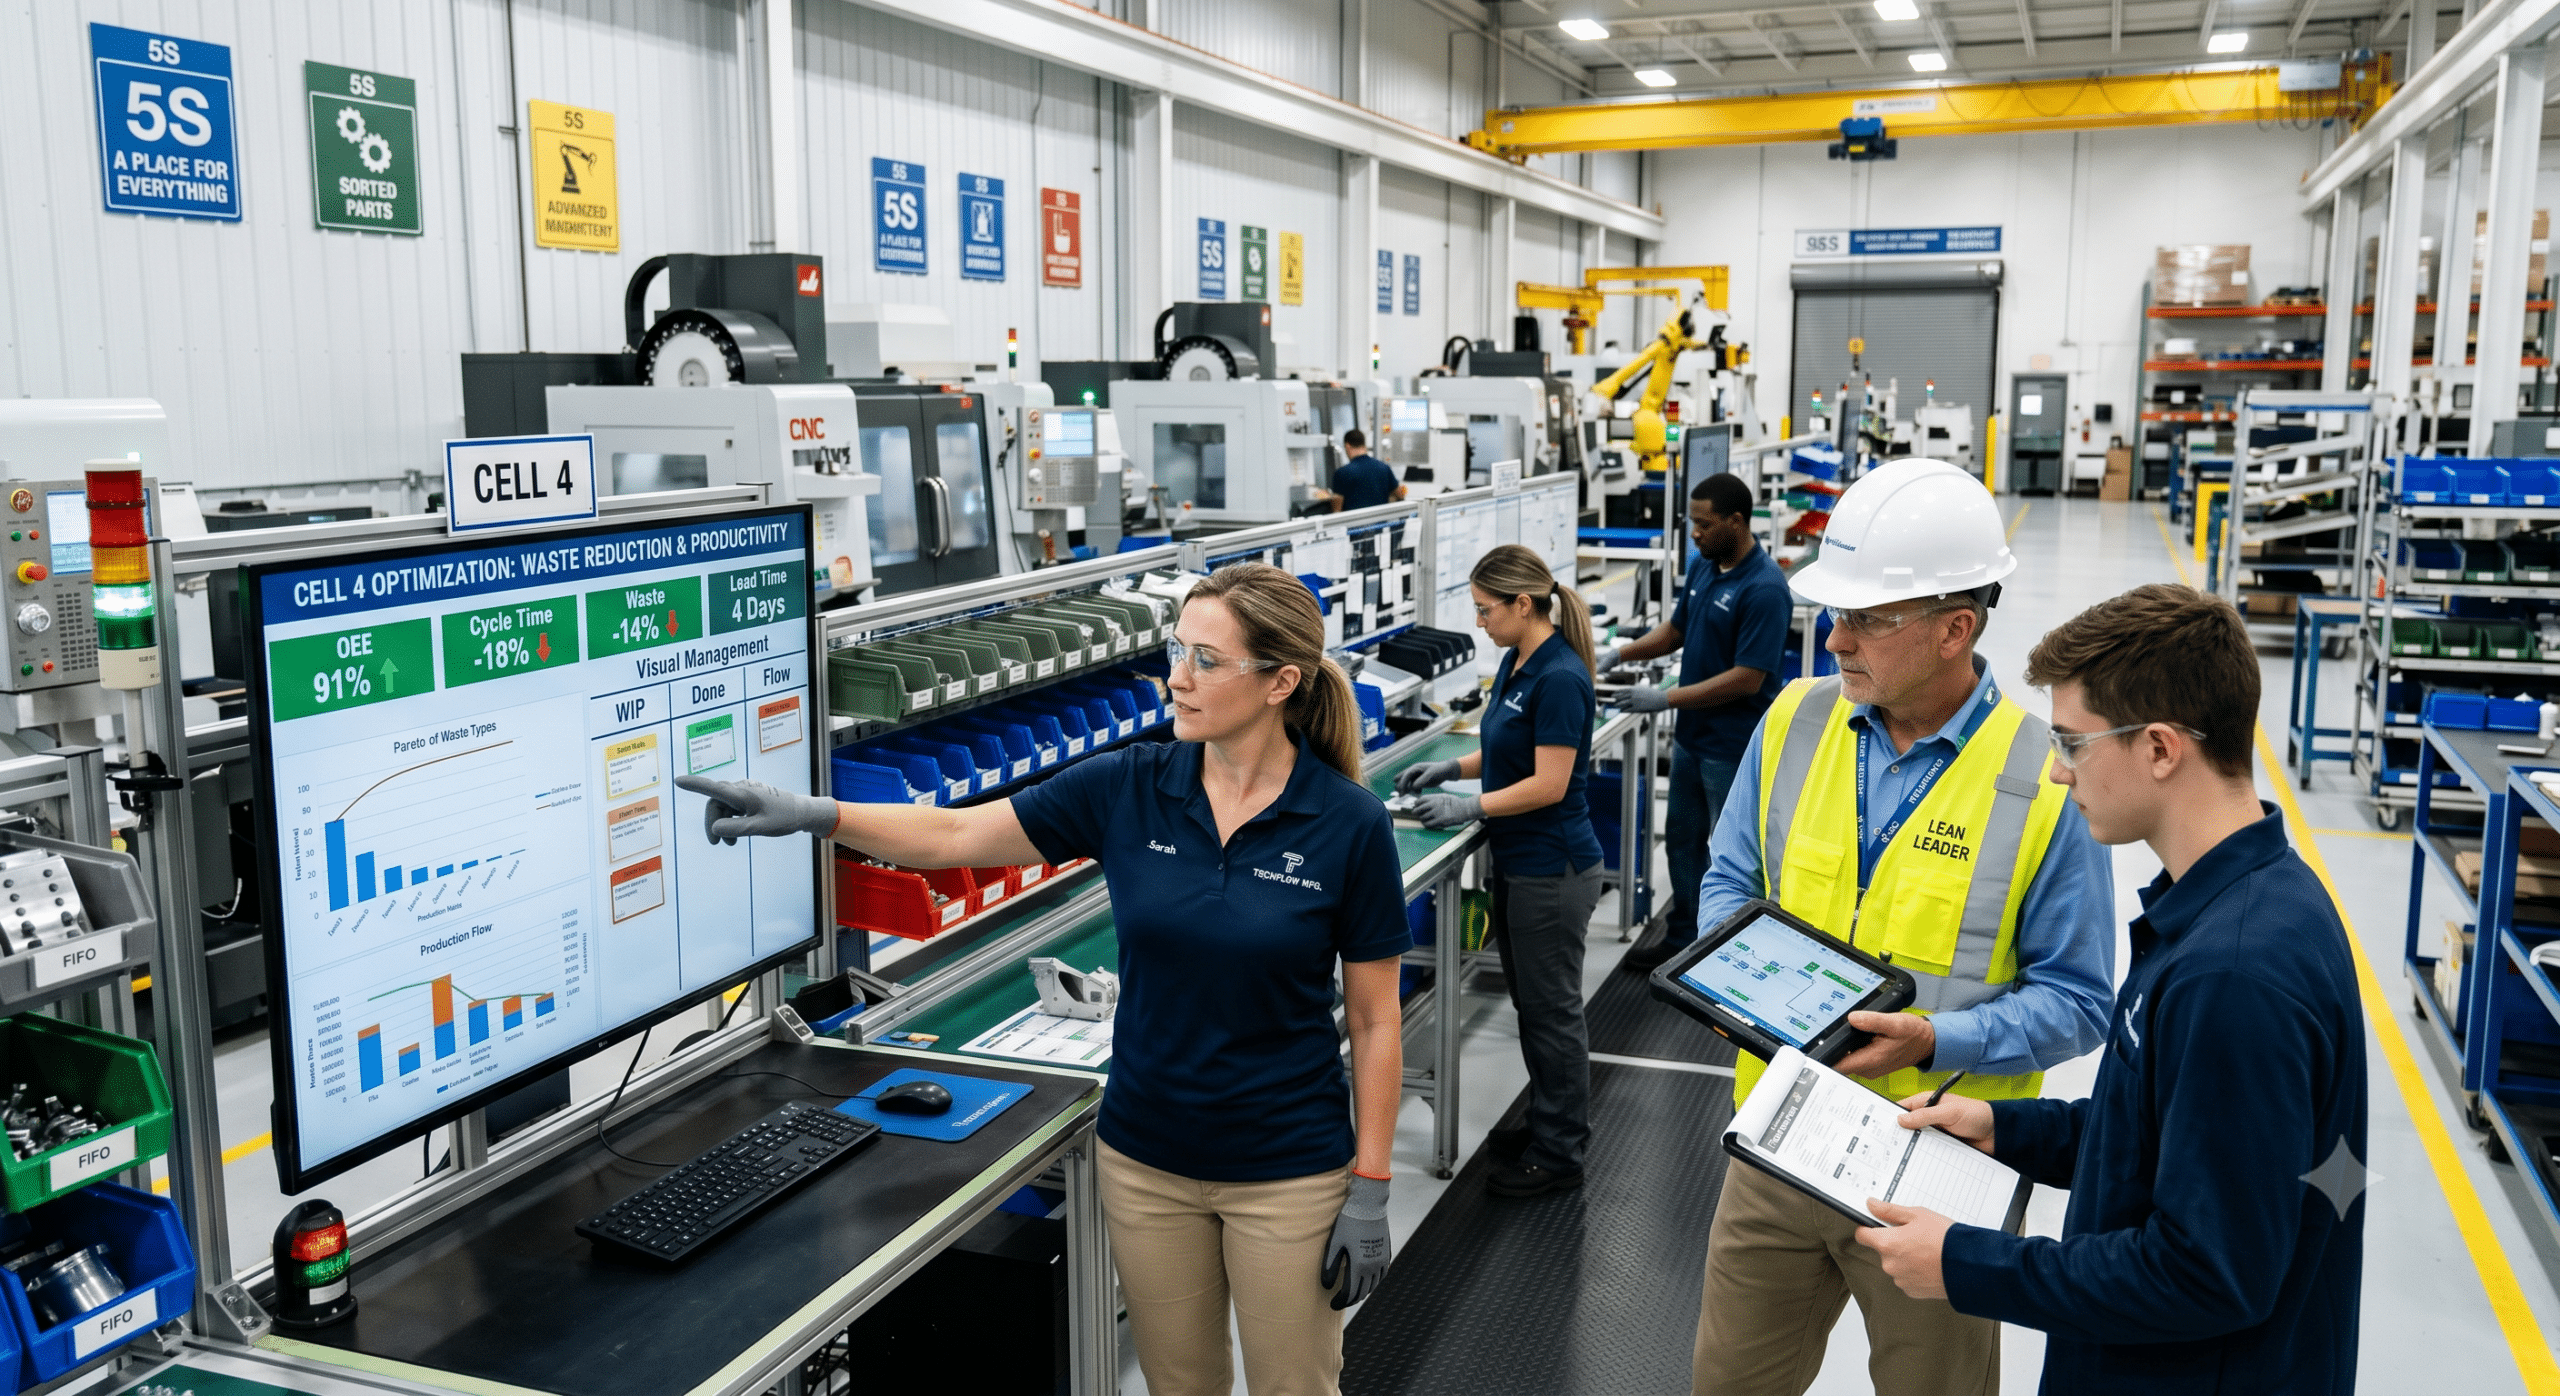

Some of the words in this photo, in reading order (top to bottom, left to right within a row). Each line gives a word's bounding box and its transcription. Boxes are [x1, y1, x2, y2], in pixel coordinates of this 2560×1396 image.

[148, 40, 181, 66] 5S
[349, 74, 377, 98] 5S
[126, 81, 213, 147] 5S
[564, 110, 585, 131] 5S
[114, 150, 128, 171] A
[131, 153, 191, 178] PLACE
[194, 160, 229, 182] FOR
[892, 163, 908, 181] 5S
[117, 175, 229, 204] EVERYTHING
[339, 176, 398, 200] SORTED
[345, 200, 394, 221] PARTS
[884, 190, 919, 231] 5S
[1202, 240, 1223, 268] 5S
[789, 417, 826, 441] CNC
[473, 461, 548, 504] CELL
[556, 460, 573, 496] 4
[294, 577, 347, 607] CELL
[353, 574, 367, 600] 4
[371, 556, 516, 597] OPTIMIZATION:
[520, 549, 580, 577] WASTE
[584, 539, 673, 569] REDUCTION
[676, 536, 688, 556] &
[690, 522, 789, 553] PRODUCTIVITY
[729, 572, 757, 592] Lead
[760, 569, 788, 587] Time
[625, 587, 666, 610] Waste
[731, 600, 743, 623] 4
[746, 595, 787, 622] Days
[469, 610, 512, 639] Cycle
[517, 606, 554, 631] Time
[611, 614, 661, 645] -14%
[335, 632, 374, 659] OEE
[473, 637, 530, 672] -18%
[636, 653, 680, 680] Visual
[684, 635, 769, 668] Management
[314, 665, 371, 704] 91%
[763, 666, 791, 687] Flow
[692, 682, 726, 705] Done
[615, 698, 646, 723] WIP
[393, 736, 427, 754] Pareto
[429, 731, 439, 746] of
[440, 727, 469, 744] Waste
[470, 720, 498, 740] Types
[298, 783, 311, 794] 100
[1927, 819, 1966, 841] LEAN
[1149, 840, 1177, 855] Sarah
[1912, 834, 1970, 862] LEADER
[420, 928, 470, 957] Production
[471, 922, 494, 942] Flow
[62, 947, 97, 969] FIFO
[78, 1145, 111, 1169] FIFO
[99, 1308, 134, 1335] FIFO
